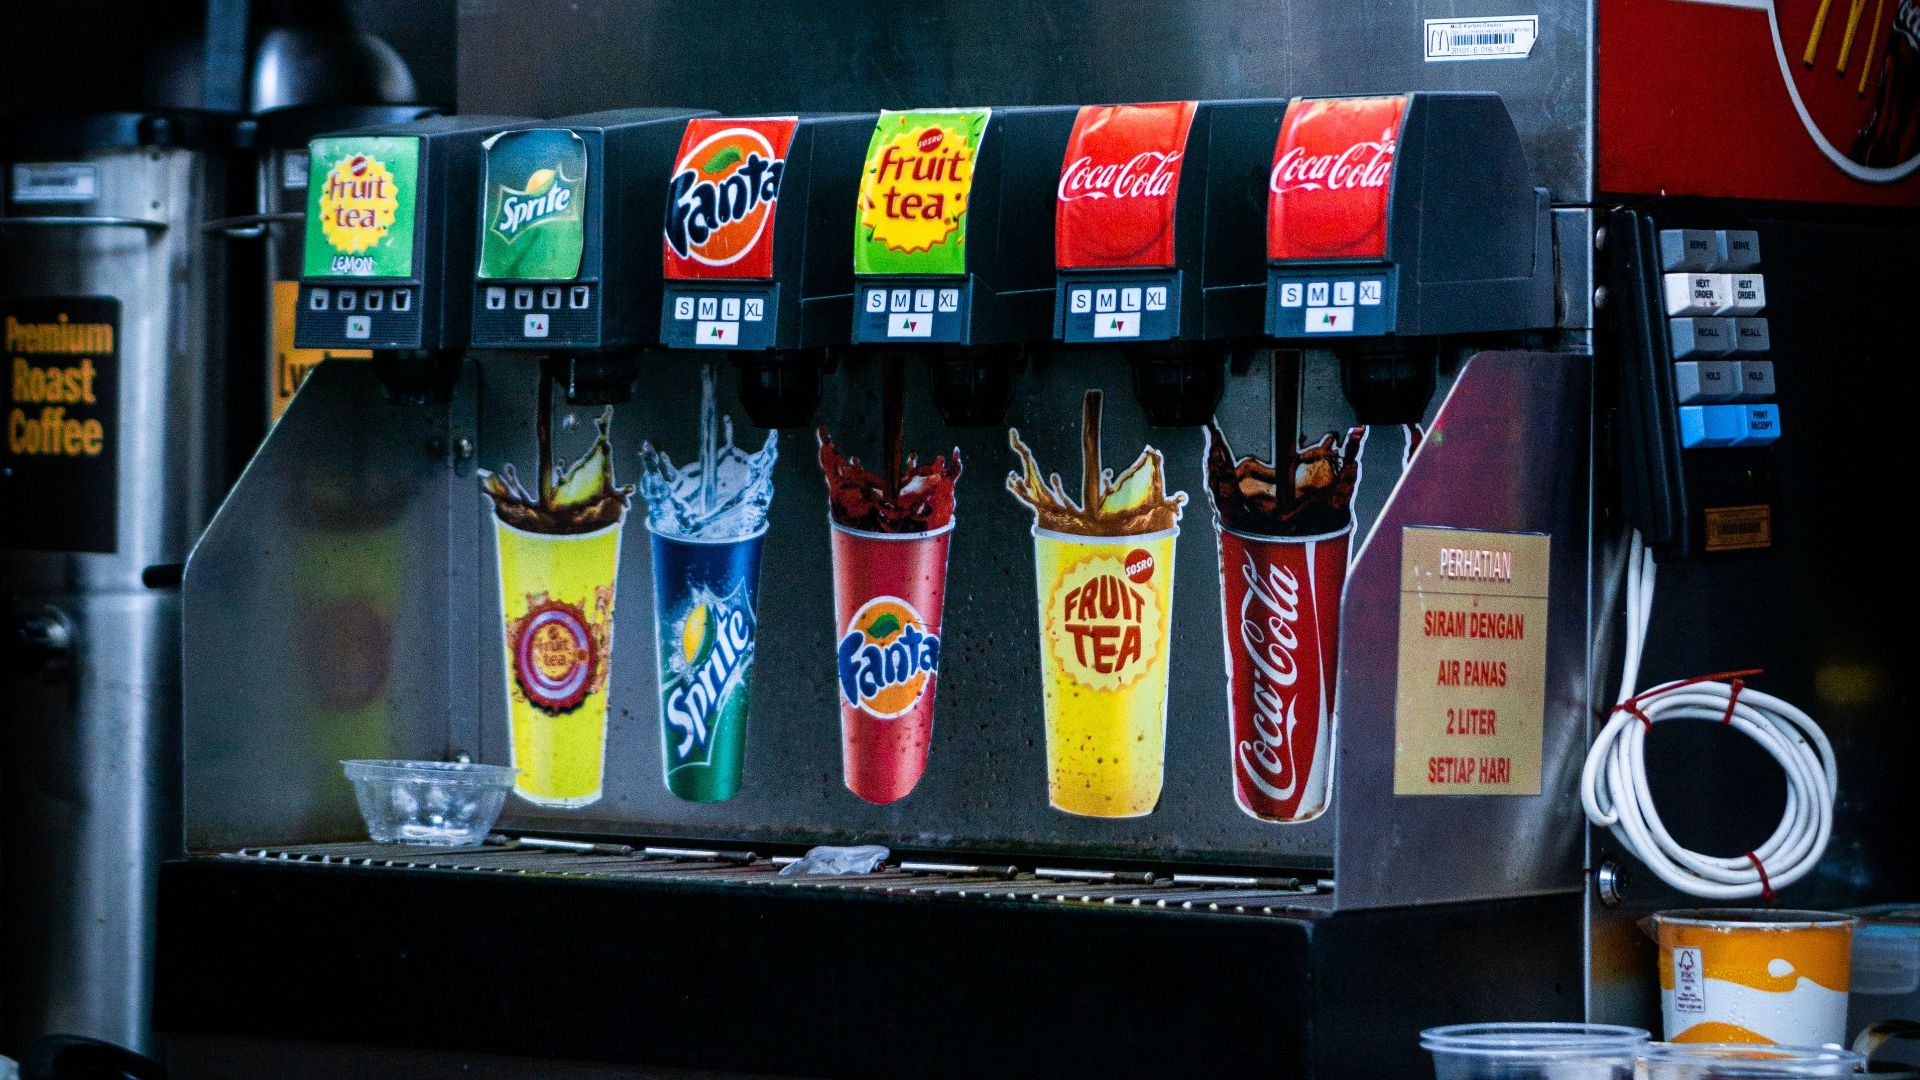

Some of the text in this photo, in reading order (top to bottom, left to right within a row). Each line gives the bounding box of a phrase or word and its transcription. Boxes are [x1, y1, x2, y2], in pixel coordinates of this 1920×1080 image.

[877, 146, 965, 184] fruit
[1058, 151, 1184, 202] Coca-Cola
[1270, 141, 1397, 193] Coca-Cola
[329, 173, 388, 202] fruit
[883, 186, 945, 220] tea
[333, 203, 376, 228] tea
[500, 184, 570, 233] Sprite
[665, 154, 783, 258] Fanta
[331, 254, 375, 272] LEMON
[1286, 286, 1380, 302] S M L XL
[1694, 290, 1714, 299] ORDER
[1695, 279, 1710, 288] NEXT
[1738, 280, 1753, 289] NEXT
[1738, 290, 1756, 300] ORDER
[680, 301, 763, 316] S M L XL
[872, 293, 957, 307] S M L XL
[1076, 291, 1165, 308] S M L XL
[5, 313, 114, 354] Premium
[12, 357, 97, 404] Roast
[8, 406, 104, 456] Coffee
[1126, 556, 1154, 577] SOSRO
[1440, 547, 1512, 579] PERHATIAN
[1064, 574, 1146, 623] FRUIT
[1424, 609, 1524, 640] SIRAM DENGAN
[1064, 624, 1142, 674] TEA
[838, 624, 939, 706] Fanta
[1239, 549, 1299, 801] Coca-Cola
[1437, 660, 1507, 687] AIR PANAS
[667, 605, 749, 758] Sprite
[1446, 708, 1496, 735] 2 LITER
[1428, 756, 1511, 784] SETIAP HARI
